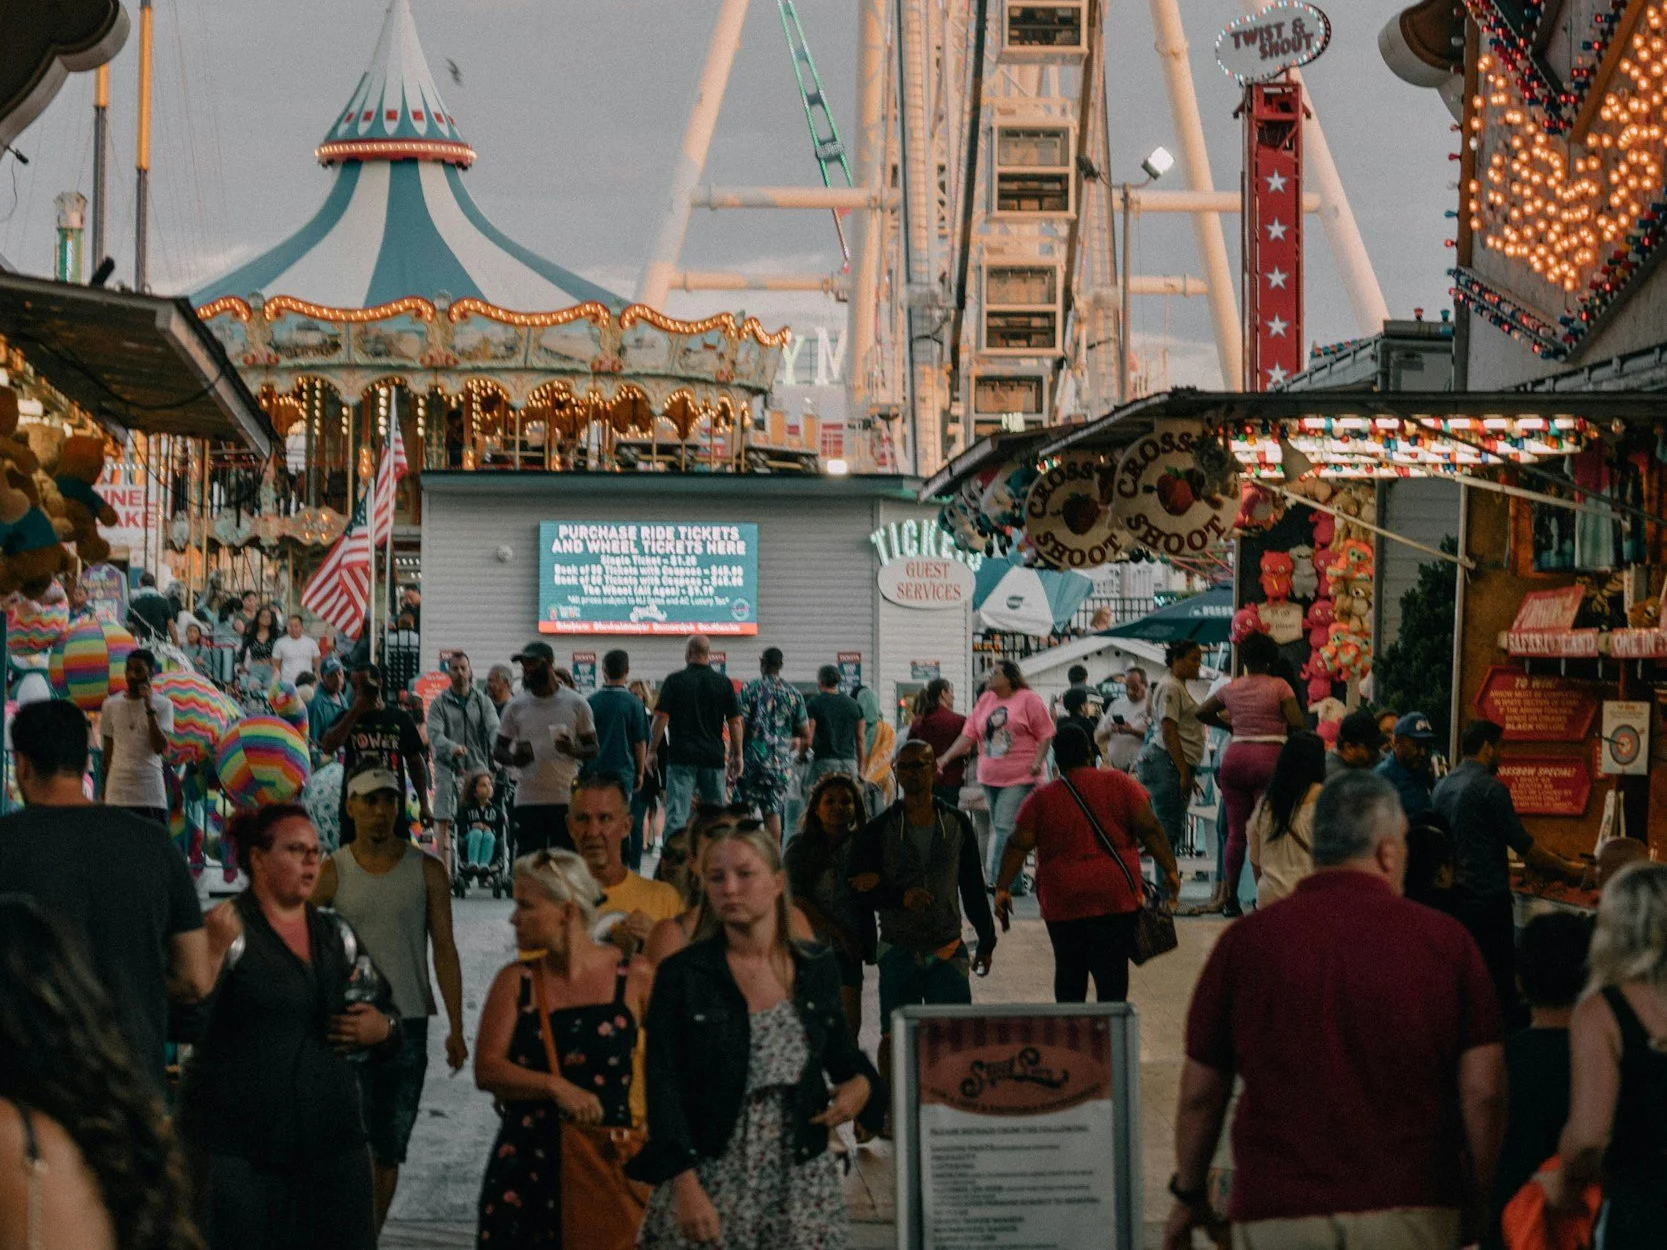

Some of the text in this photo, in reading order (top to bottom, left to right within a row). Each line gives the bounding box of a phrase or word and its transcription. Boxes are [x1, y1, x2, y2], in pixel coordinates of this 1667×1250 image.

[1230, 17, 1306, 49] TWIST &
[1258, 33, 1314, 60] SHOUT
[110, 511, 156, 528] AKE
[558, 525, 739, 541] PURCHASE RIDE TICKETS
[1126, 514, 1227, 556] SHOOT
[552, 539, 746, 555] AND WHEEL TICKETS HERE
[1036, 531, 1123, 567] SHOOT
[600, 554, 631, 567] Single
[632, 554, 661, 566] Ticket
[554, 564, 579, 575] Book
[605, 564, 638, 576] Tickets
[640, 565, 660, 576] with
[662, 565, 702, 577] Coupons
[905, 562, 950, 579] GUEST
[554, 575, 579, 585] Book
[605, 575, 638, 586] Tickets
[640, 575, 660, 586] with
[662, 576, 702, 587] Coupons
[583, 584, 602, 596] The
[603, 584, 633, 596] Wheel
[897, 582, 961, 601] SERVICES
[1515, 677, 1529, 689] TO
[1505, 723, 1534, 731] BLACK
